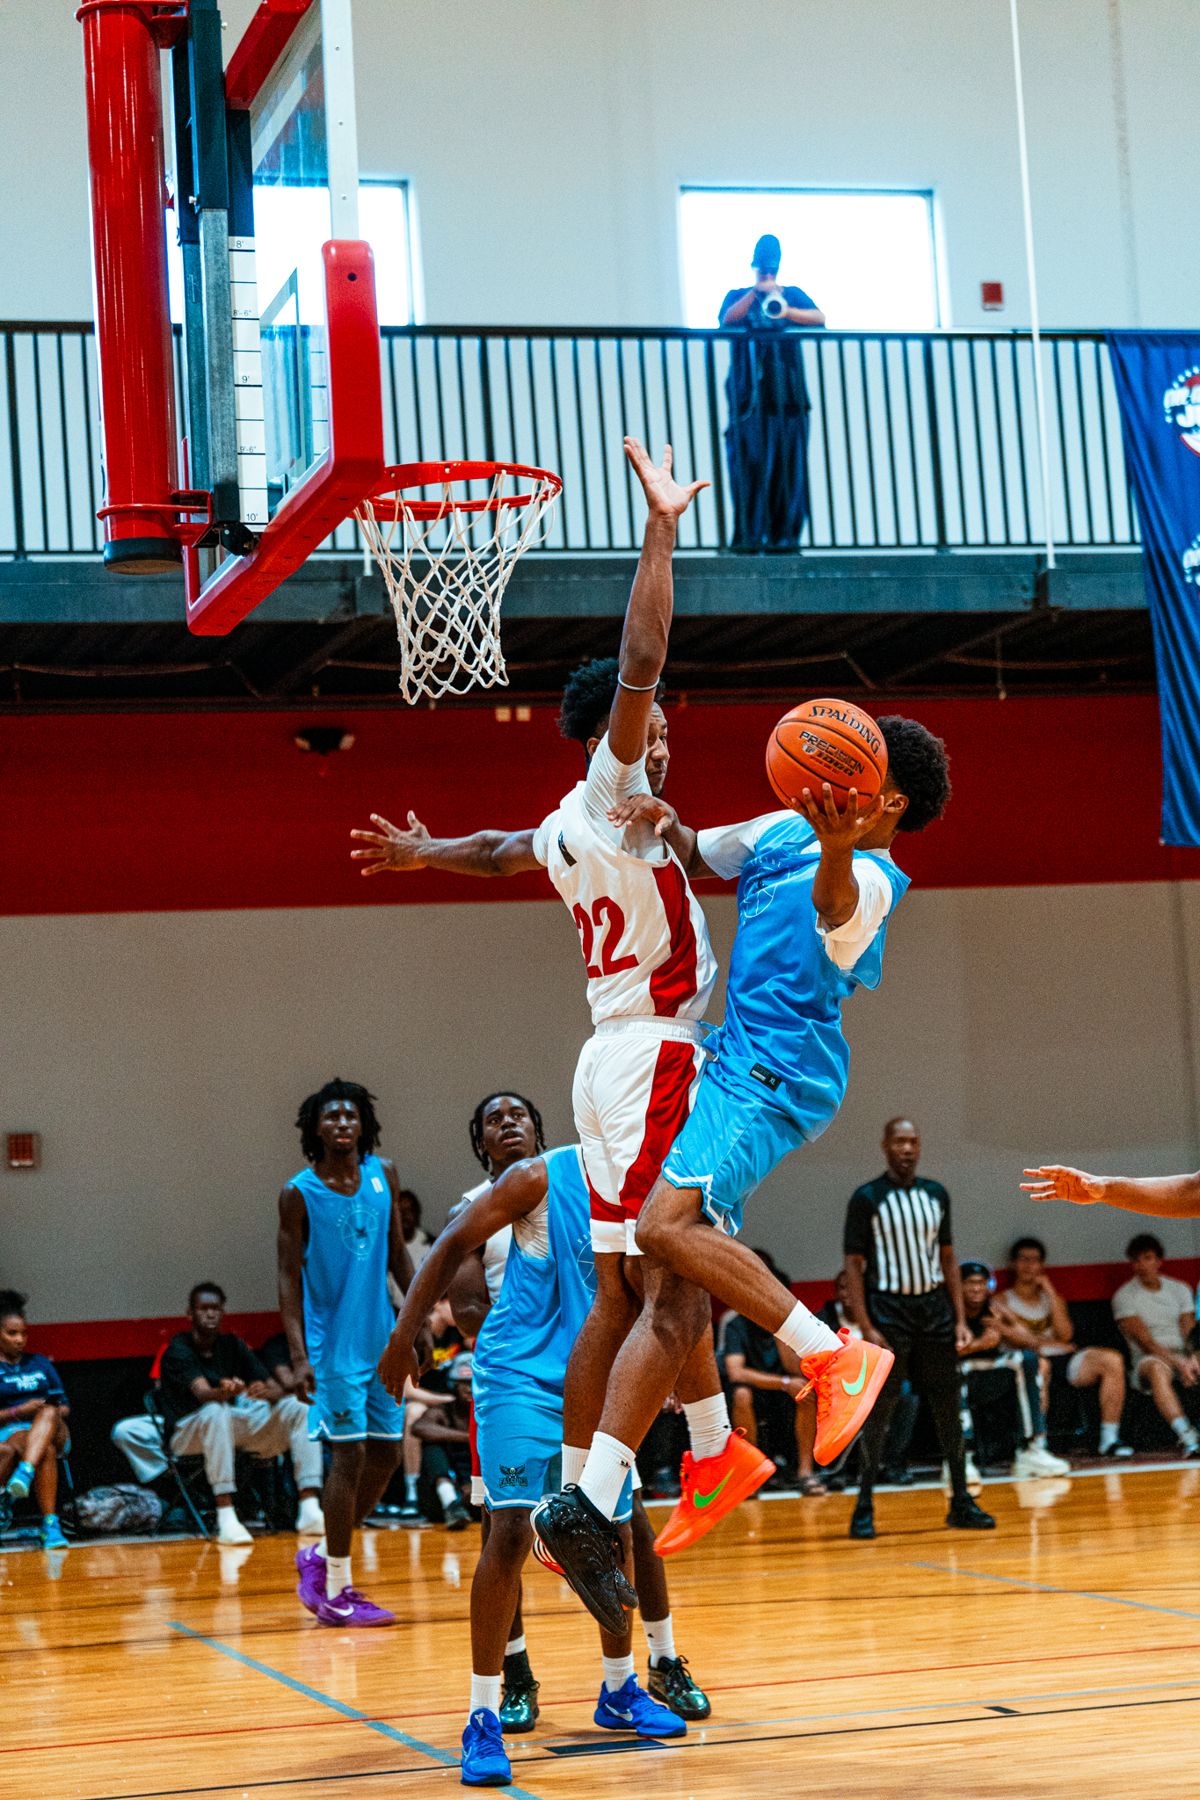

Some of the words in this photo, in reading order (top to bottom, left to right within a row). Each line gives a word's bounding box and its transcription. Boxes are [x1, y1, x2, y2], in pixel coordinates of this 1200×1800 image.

[799, 731, 865, 775] PRECISION
[808, 705, 881, 757] SPALDING
[573, 896, 639, 978] 22
